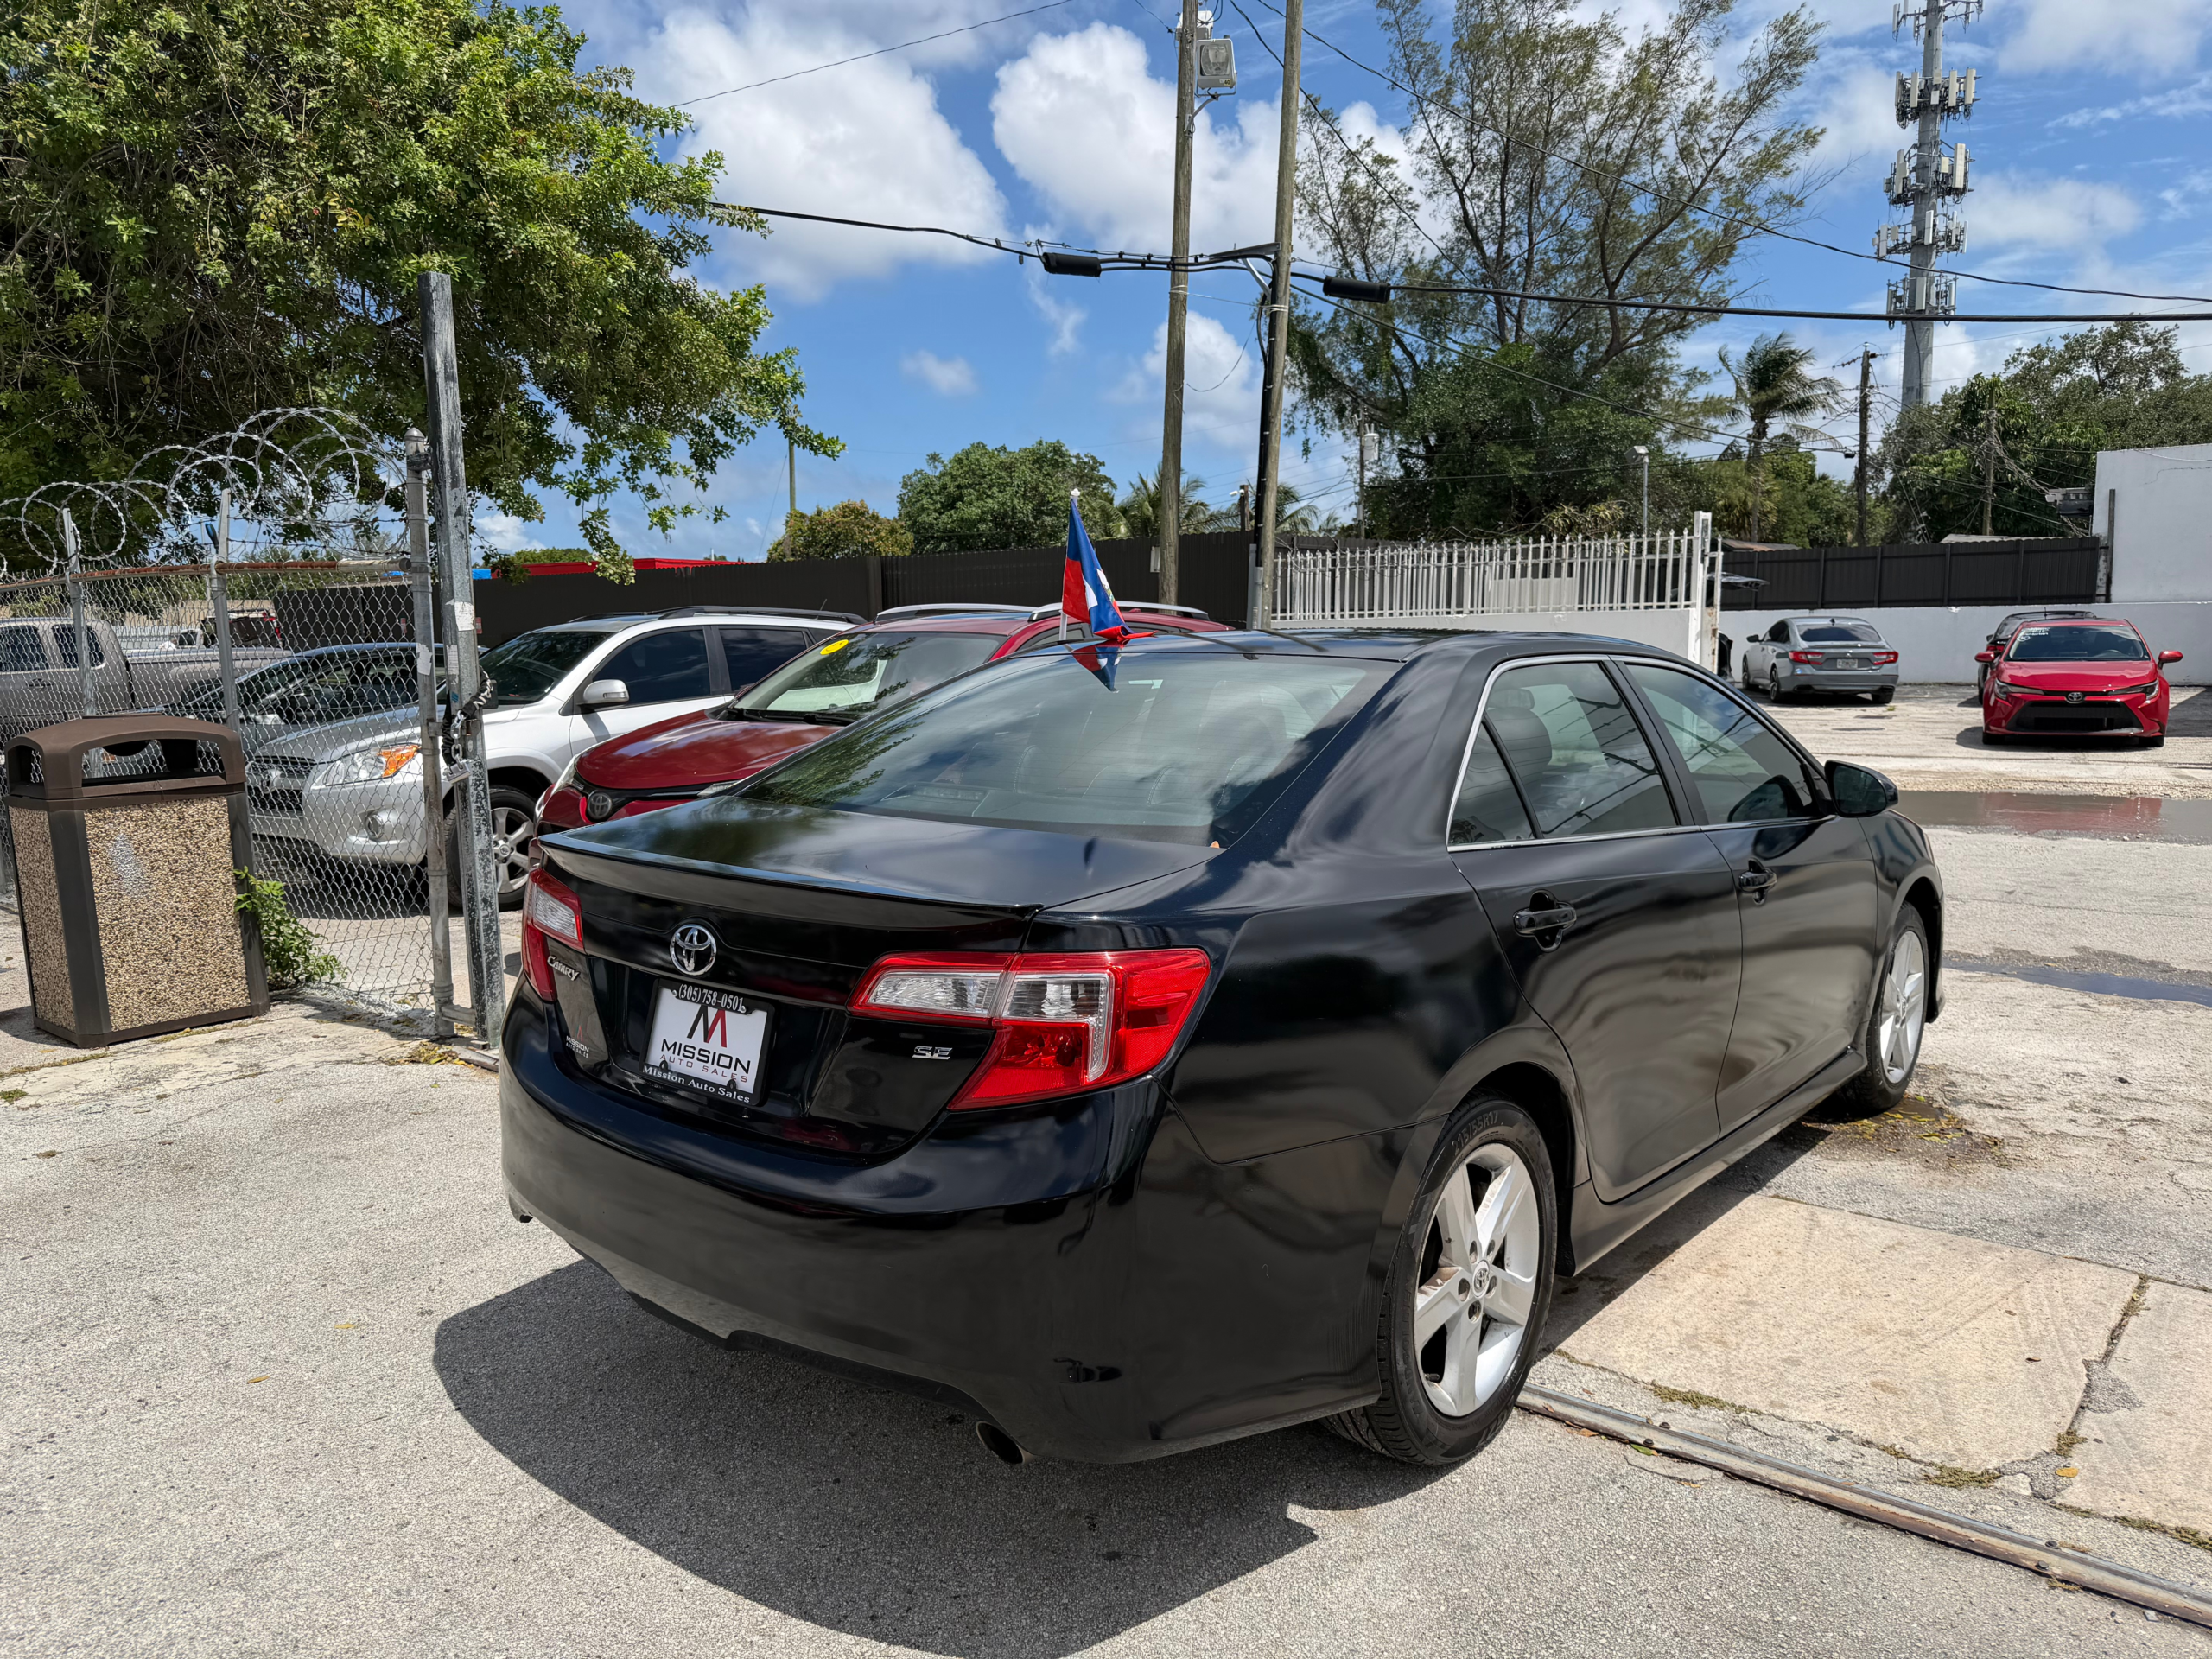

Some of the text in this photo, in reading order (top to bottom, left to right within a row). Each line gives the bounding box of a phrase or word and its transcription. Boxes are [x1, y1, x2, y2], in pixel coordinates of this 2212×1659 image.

[566, 1035, 589, 1052] MISSION
[661, 1039, 751, 1074] MISSION
[912, 1046, 953, 1060] SE
[660, 1054, 748, 1083] AUTO SALES
[643, 1065, 750, 1103] Mission Auto Sales
